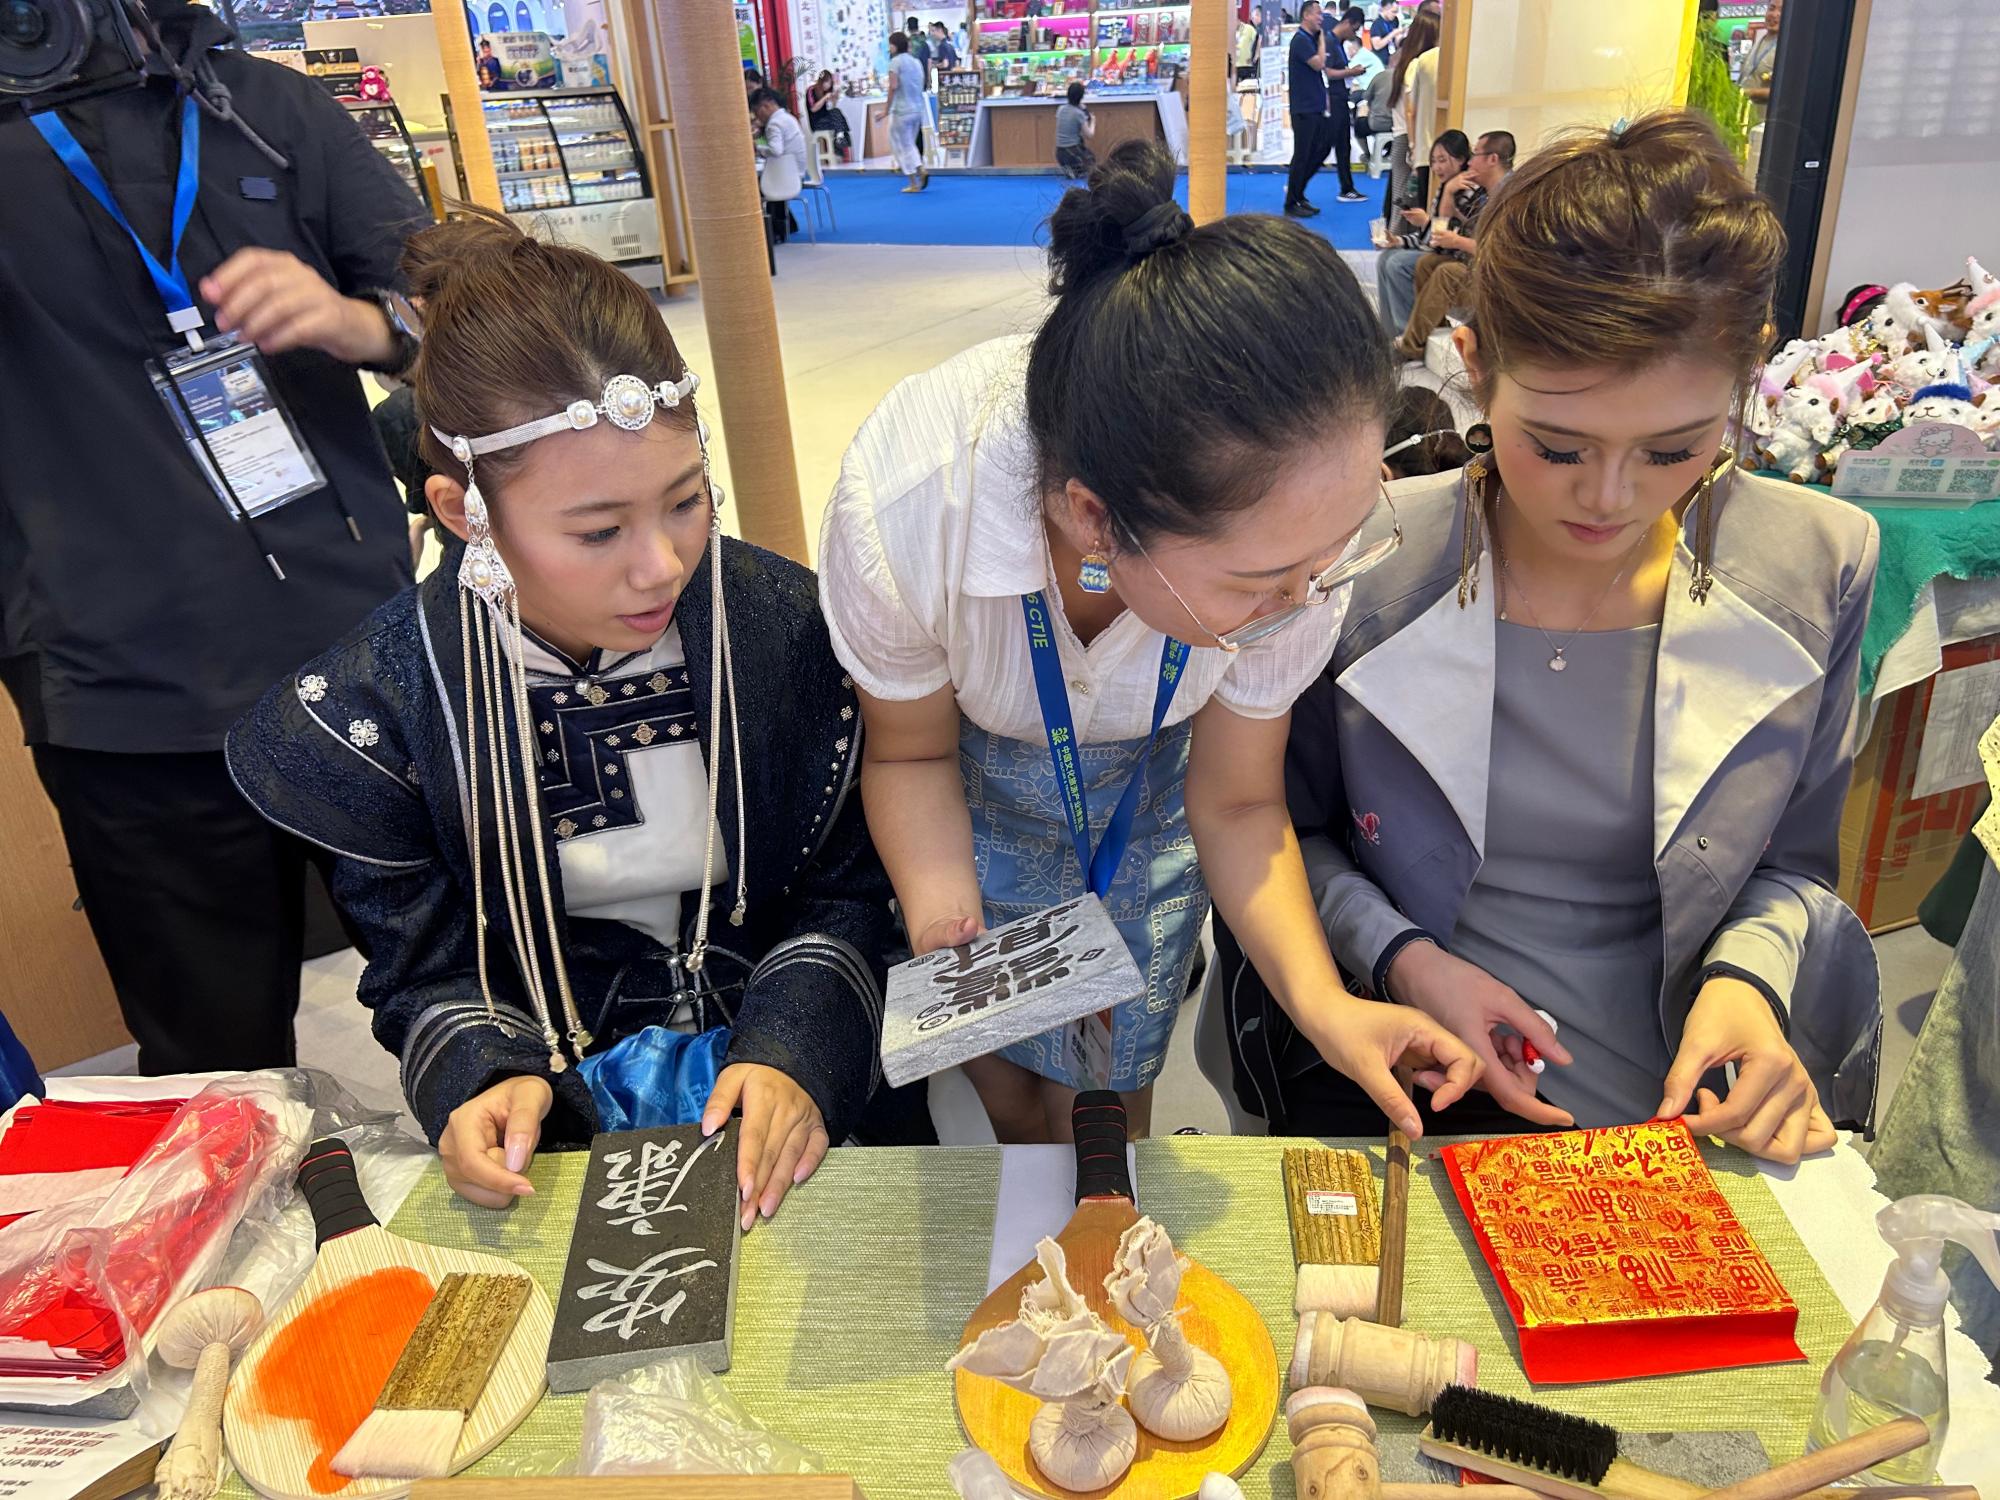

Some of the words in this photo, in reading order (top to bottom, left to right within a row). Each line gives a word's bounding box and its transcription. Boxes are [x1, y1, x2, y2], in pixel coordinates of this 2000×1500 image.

[1026, 592, 1039, 605] 6
[1029, 608, 1049, 649] CTIE
[577, 1131, 726, 1340] 安康
